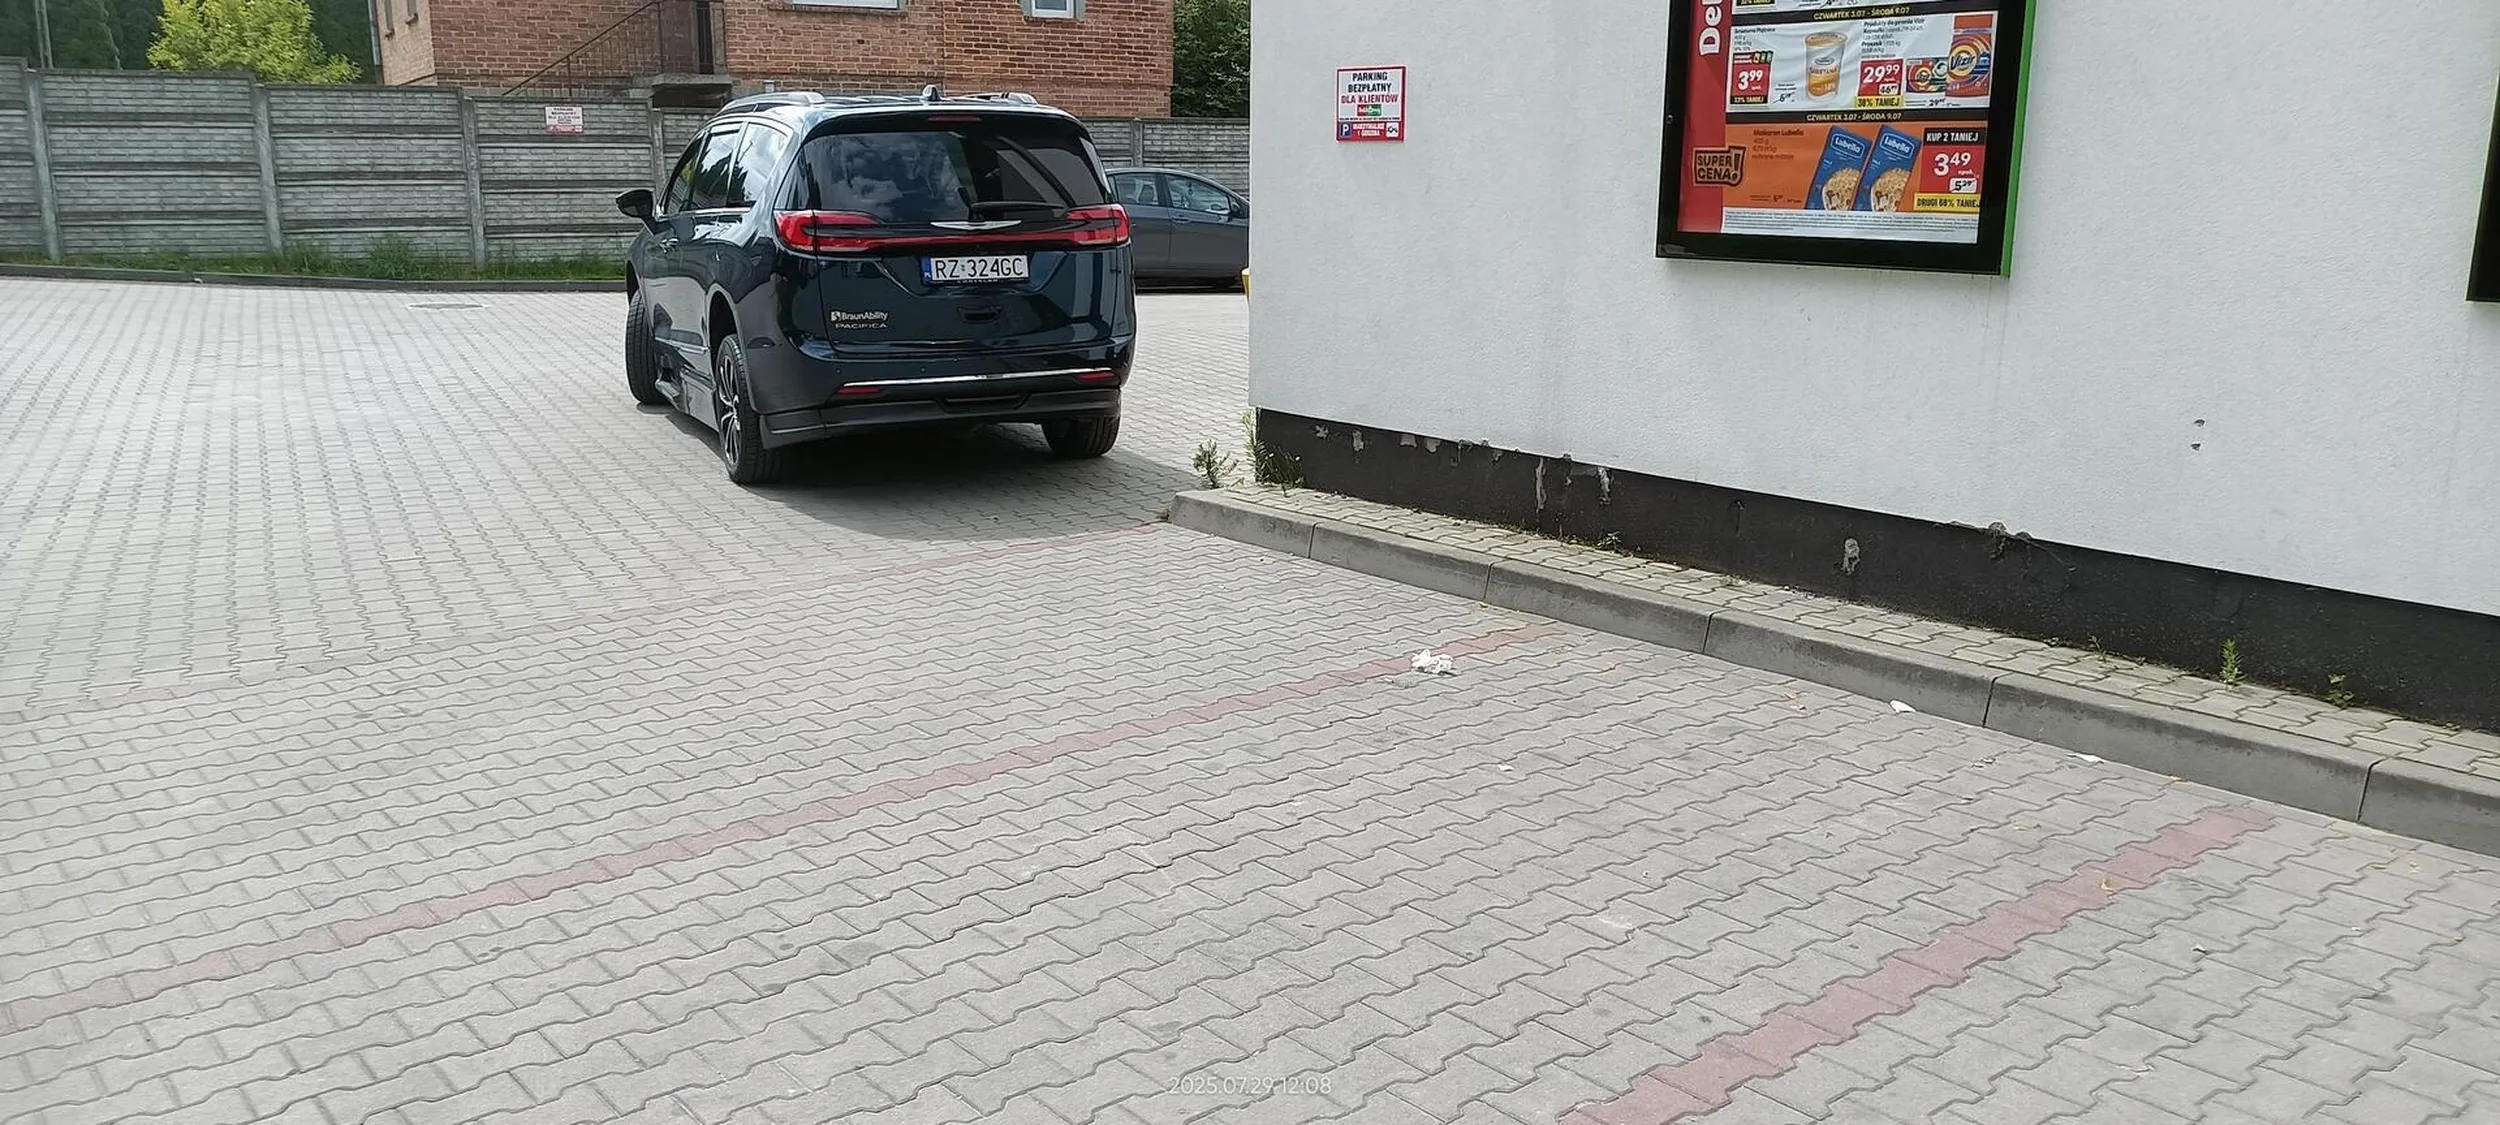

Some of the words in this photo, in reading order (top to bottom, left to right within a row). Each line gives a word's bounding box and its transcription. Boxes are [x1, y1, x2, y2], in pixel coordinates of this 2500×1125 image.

[1699, 0, 1722, 55] De
[1950, 54, 1976, 70] Vizir
[1352, 72, 1388, 82] PARKING
[1347, 83, 1392, 93] BEZPŁATNY
[1341, 95, 1357, 104] DLA
[1342, 123, 1350, 137] P
[1926, 132, 1942, 141] KUP
[1943, 133, 1948, 141] 2
[1950, 132, 1979, 141] TANIEJ
[1835, 137, 1861, 153] Lubella
[1884, 136, 1910, 153] Lubella
[1698, 154, 1732, 167] SUPER
[935, 259, 960, 278] RZ
[967, 258, 1024, 277] 324GC
[841, 311, 888, 321] BraunAbility
